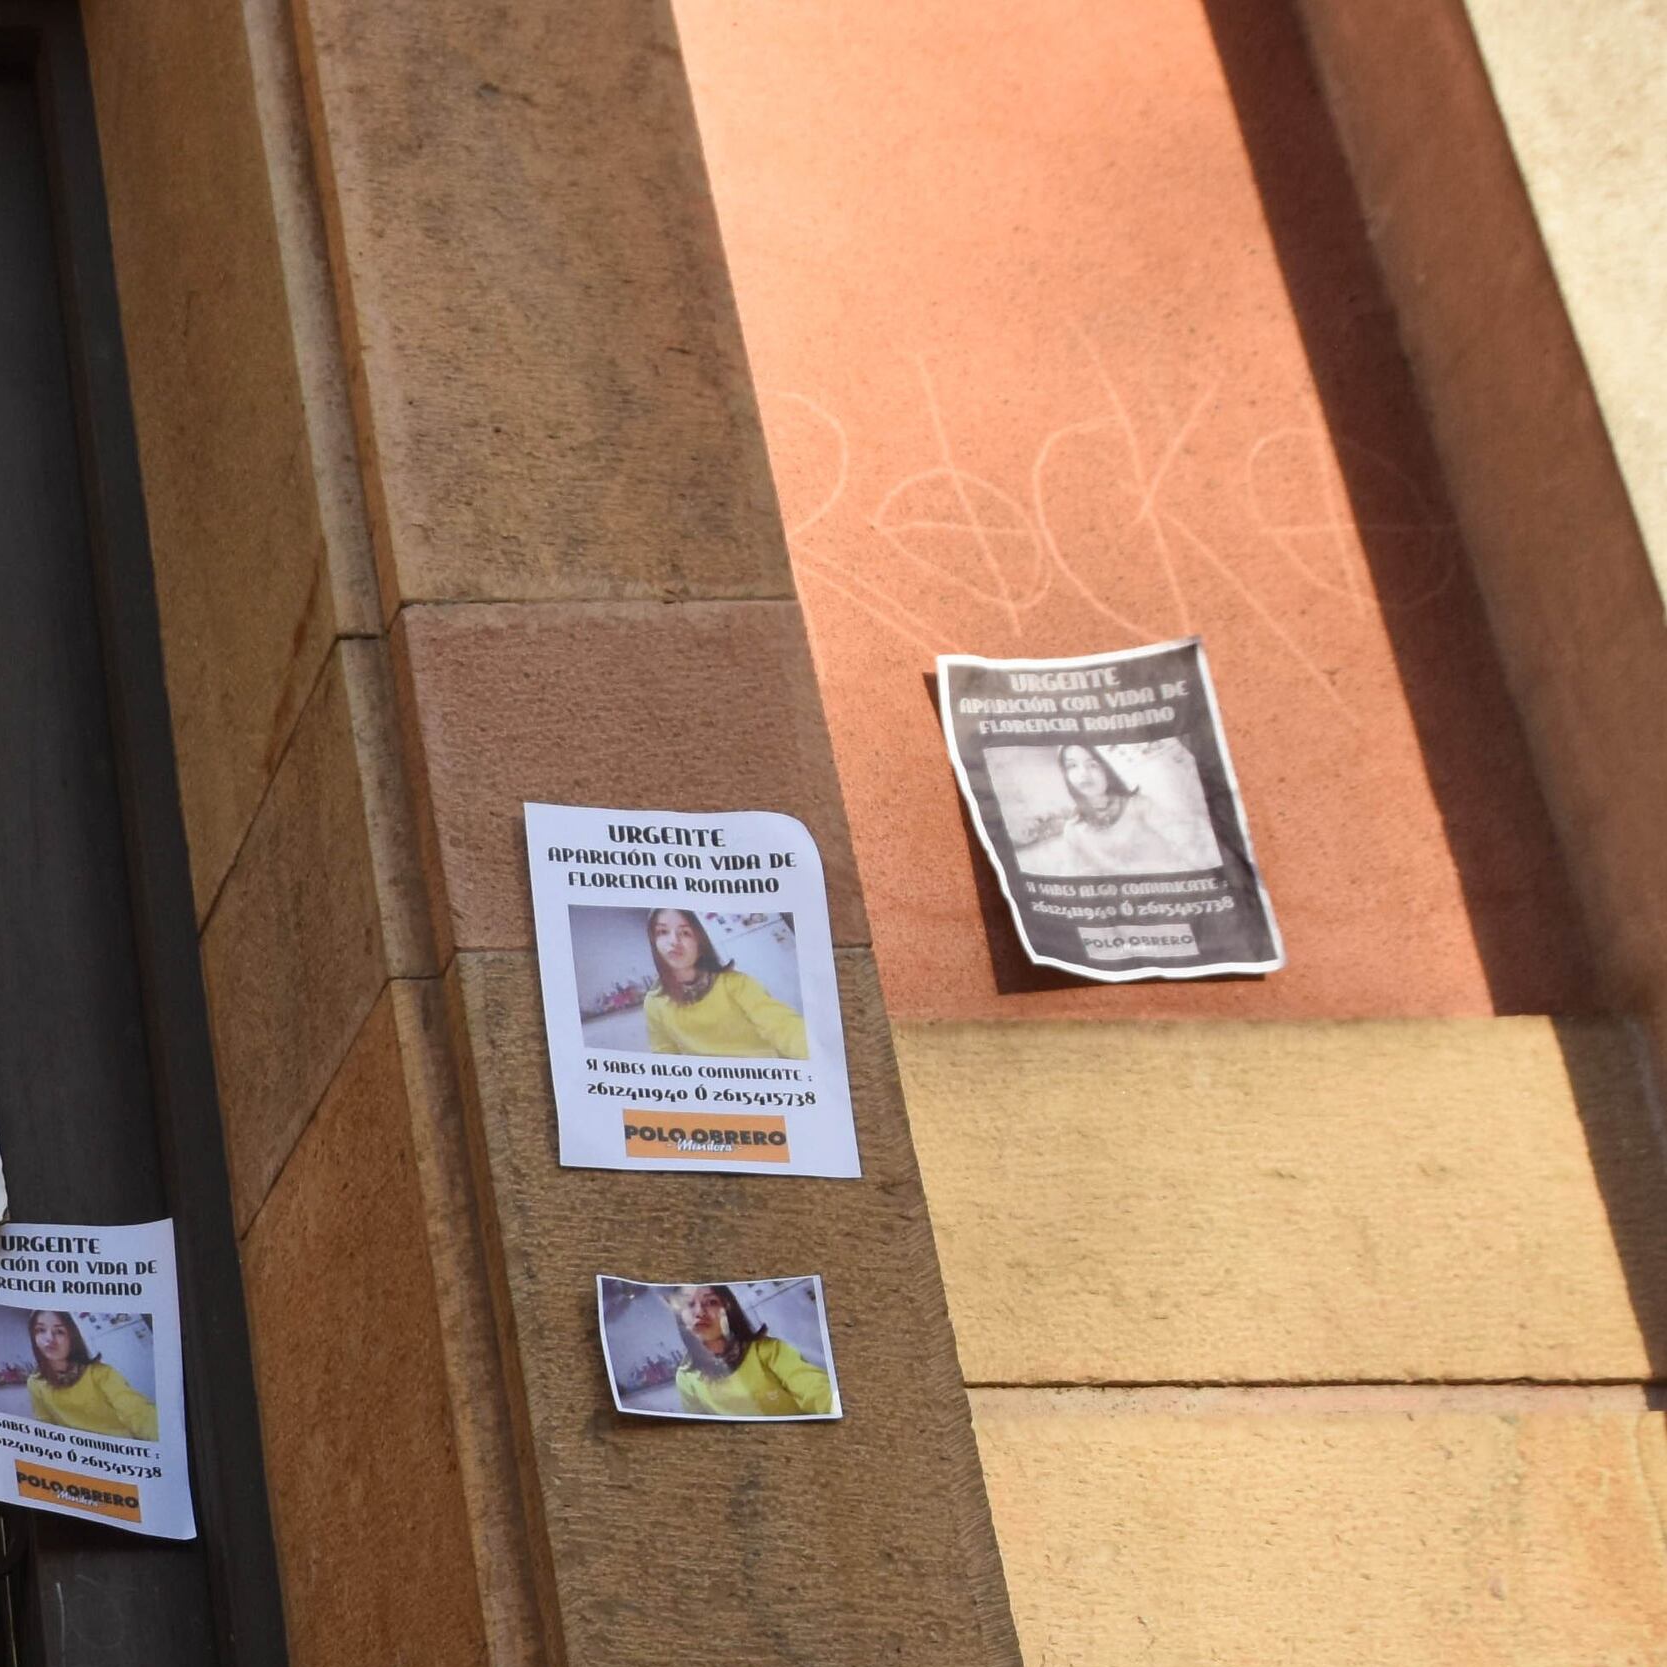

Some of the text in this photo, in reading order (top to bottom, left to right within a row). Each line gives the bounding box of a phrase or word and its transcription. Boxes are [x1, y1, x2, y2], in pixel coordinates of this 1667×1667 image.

[1009, 667, 1120, 693] URGENTE
[608, 824, 725, 847] URGENTE
[548, 847, 796, 871] APARICIÓN CON VIDA DE
[568, 871, 779, 894] FLORENCIA ROMANO
[586, 1059, 597, 1071] SI
[603, 1060, 645, 1074] SABES
[651, 1064, 692, 1077] ALGO
[624, 1124, 786, 1146] POLO OBRERO
[1, 1236, 101, 1254] URGENTE
[63, 1281, 142, 1296] ROMANO
